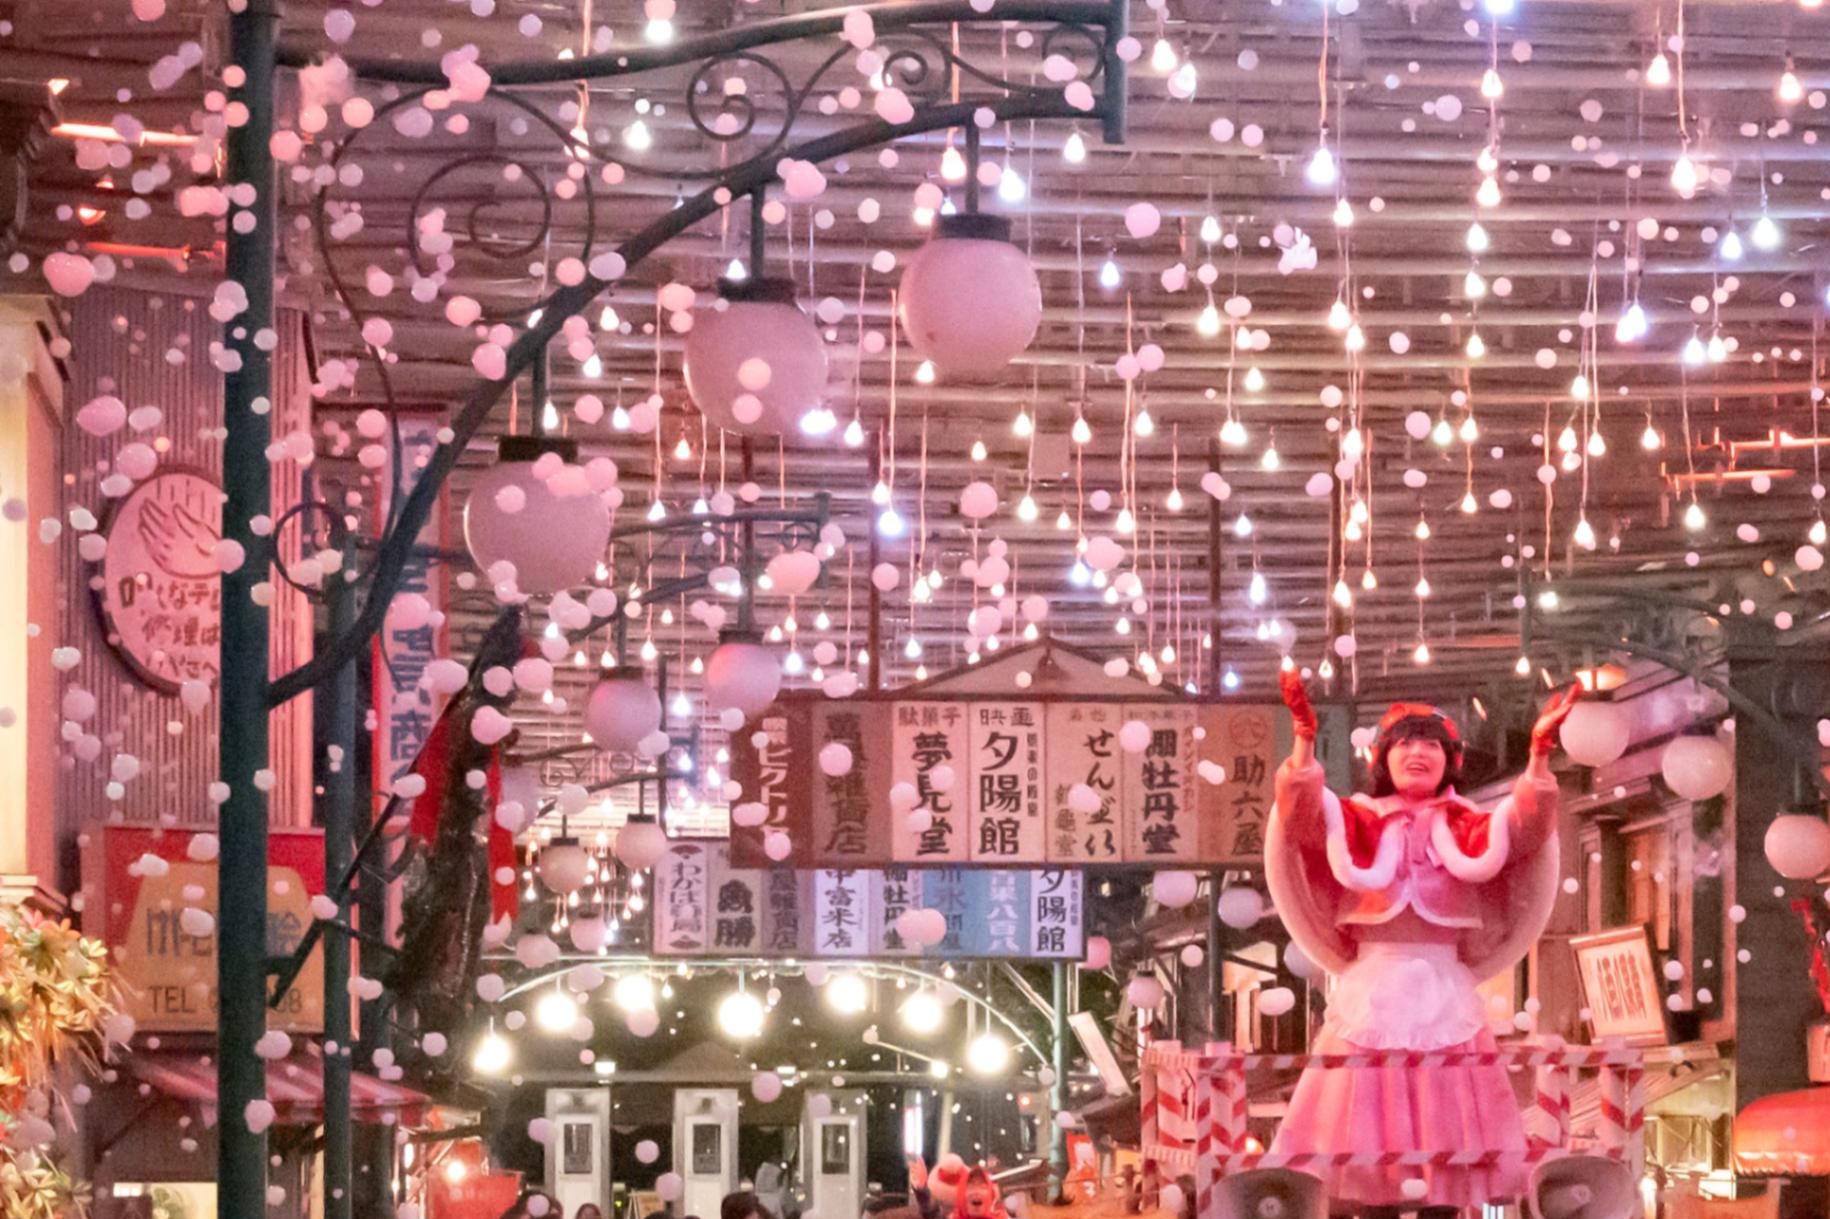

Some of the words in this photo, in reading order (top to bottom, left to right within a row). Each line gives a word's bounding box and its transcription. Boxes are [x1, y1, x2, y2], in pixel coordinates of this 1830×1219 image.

[911, 730, 953, 856] 夢見堂
[978, 731, 1022, 855] 夕陽館
[1230, 754, 1266, 855] 助六屋
[149, 986, 196, 1014] TEL
